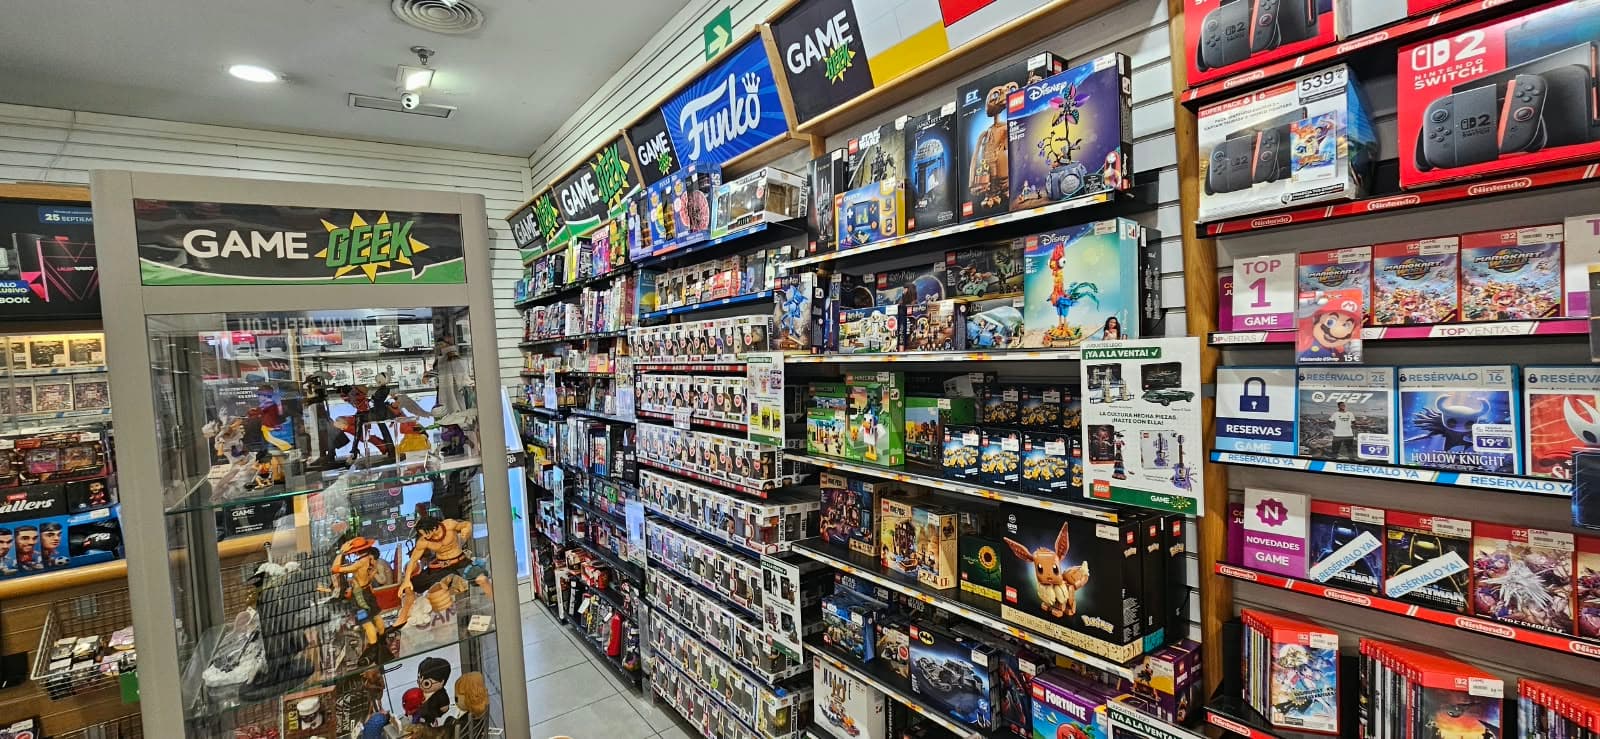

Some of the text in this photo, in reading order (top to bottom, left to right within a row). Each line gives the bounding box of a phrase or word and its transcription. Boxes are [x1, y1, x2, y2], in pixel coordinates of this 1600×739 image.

[786, 10, 853, 74] GAME
[826, 42, 851, 80] GEEK
[1414, 58, 1484, 80] NINTENDO
[1302, 71, 1334, 92] 539
[1414, 65, 1484, 90] SWITCH
[679, 72, 761, 162] Funko
[637, 131, 671, 166] GAME
[595, 144, 628, 204] GEEK
[561, 172, 600, 216] GAME
[1473, 181, 1526, 194] Nintendo
[1371, 198, 1415, 210] Nintendo
[45, 213, 60, 221] 25
[536, 193, 557, 238] GEEK
[1254, 216, 1289, 227] Nintendo
[514, 212, 541, 245] GAME
[182, 220, 415, 268] GAME GEEK
[1243, 259, 1281, 275] TOP
[1249, 277, 1271, 308] 1
[1244, 315, 1278, 326] GAME
[1440, 325, 1520, 336] TOPVENTAS
[1105, 350, 1115, 358] LA
[1115, 349, 1149, 357] VENTA!
[1306, 371, 1364, 382] RESÉRVALO
[1408, 371, 1503, 382] RESÉRVALO 16
[1226, 424, 1282, 436] RESERVAS
[1234, 441, 1273, 451] GAME
[1282, 458, 1295, 466] YA
[1411, 452, 1456, 464] HOLLOW
[1459, 454, 1505, 467] KNIGHT
[1404, 469, 1420, 479] YA
[1150, 495, 1170, 504] GAME
[232, 509, 254, 517] GAME
[1264, 505, 1279, 520] N
[1246, 536, 1300, 550] NOVEDADES
[1255, 551, 1289, 566] GAME
[1420, 585, 1465, 602] ATMAN
[1460, 619, 1511, 636] Nintendo
[1045, 688, 1087, 721] FORTNITE
[1133, 721, 1144, 731] LA
